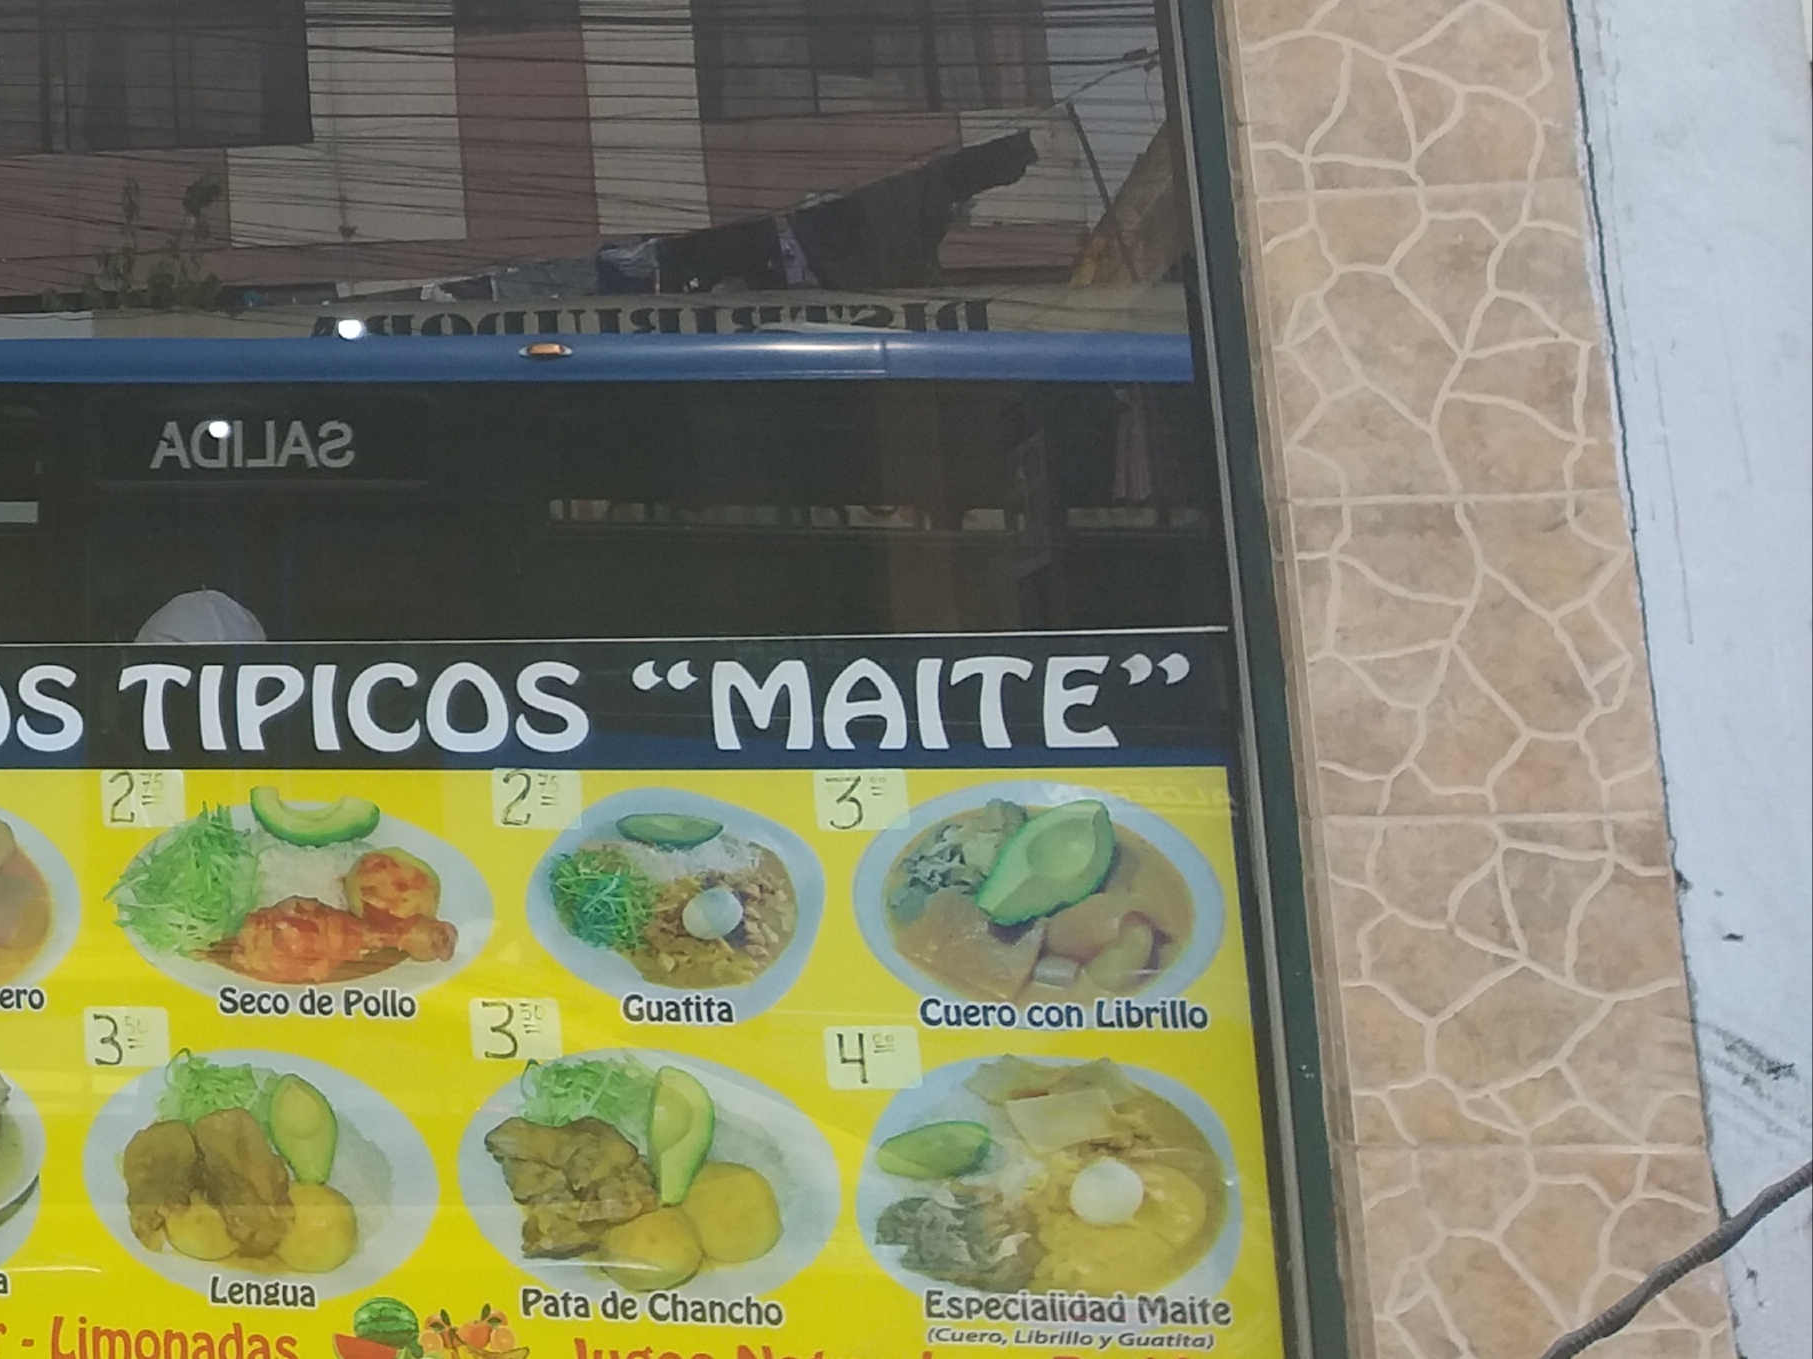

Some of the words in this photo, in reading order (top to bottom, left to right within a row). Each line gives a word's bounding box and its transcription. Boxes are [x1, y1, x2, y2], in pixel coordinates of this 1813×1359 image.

[118, 661, 590, 753] TIPICOS
[219, 988, 290, 1016] Seco
[297, 988, 334, 1017] de
[345, 989, 416, 1018] Pollo
[623, 994, 735, 1024] Guatita
[920, 998, 1016, 1028] Cuero
[1027, 1002, 1084, 1029] con
[1096, 999, 1209, 1030] Librillo
[210, 1276, 316, 1308] Lengua
[522, 1288, 589, 1318] Pata
[601, 1291, 638, 1320] de
[649, 1292, 783, 1326] Chancho
[925, 1290, 1126, 1323] Especialidad
[1137, 1295, 1232, 1326] Maite
[51, 1316, 298, 1359] Limonadas
[927, 1326, 1009, 1346] (Cuero,
[1014, 1329, 1094, 1347] Librillo
[1098, 1334, 1111, 1350] y
[1118, 1331, 1215, 1349] Guatita)
